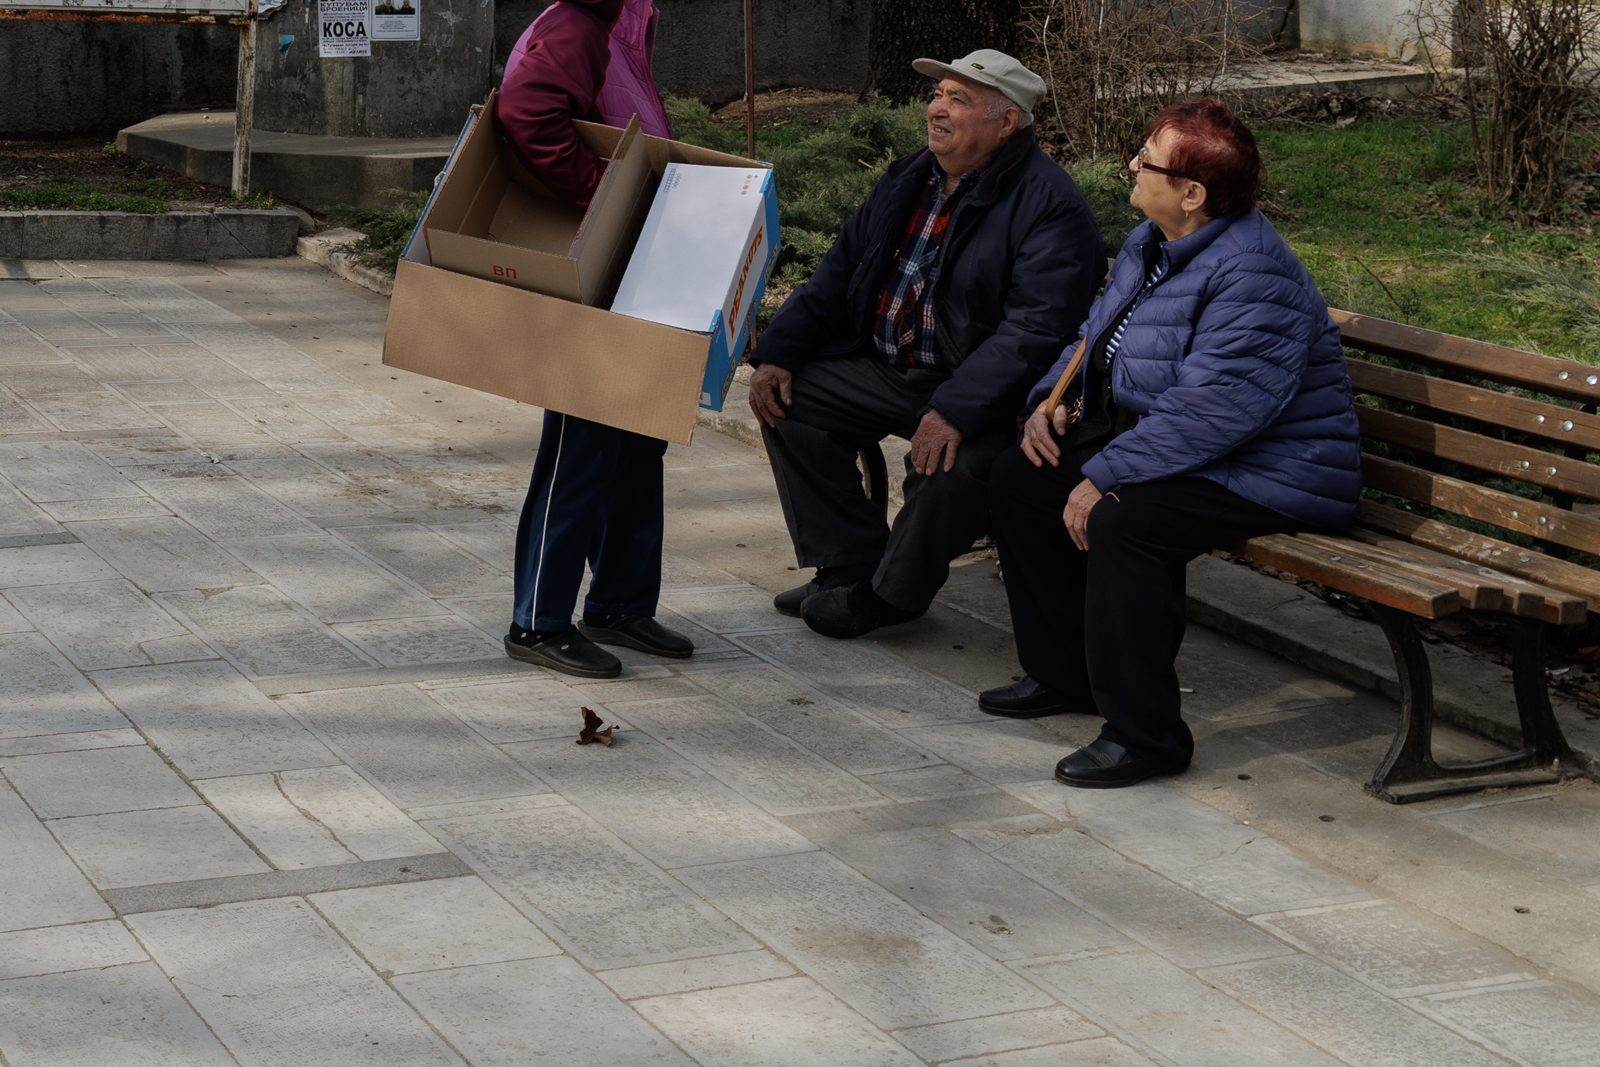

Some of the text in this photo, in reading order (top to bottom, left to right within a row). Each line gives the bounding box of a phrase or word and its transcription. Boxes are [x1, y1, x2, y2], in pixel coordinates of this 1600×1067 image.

[323, 21, 367, 38] КОСА
[492, 264, 517, 279] ВП
[728, 224, 764, 341] PEANUTS
